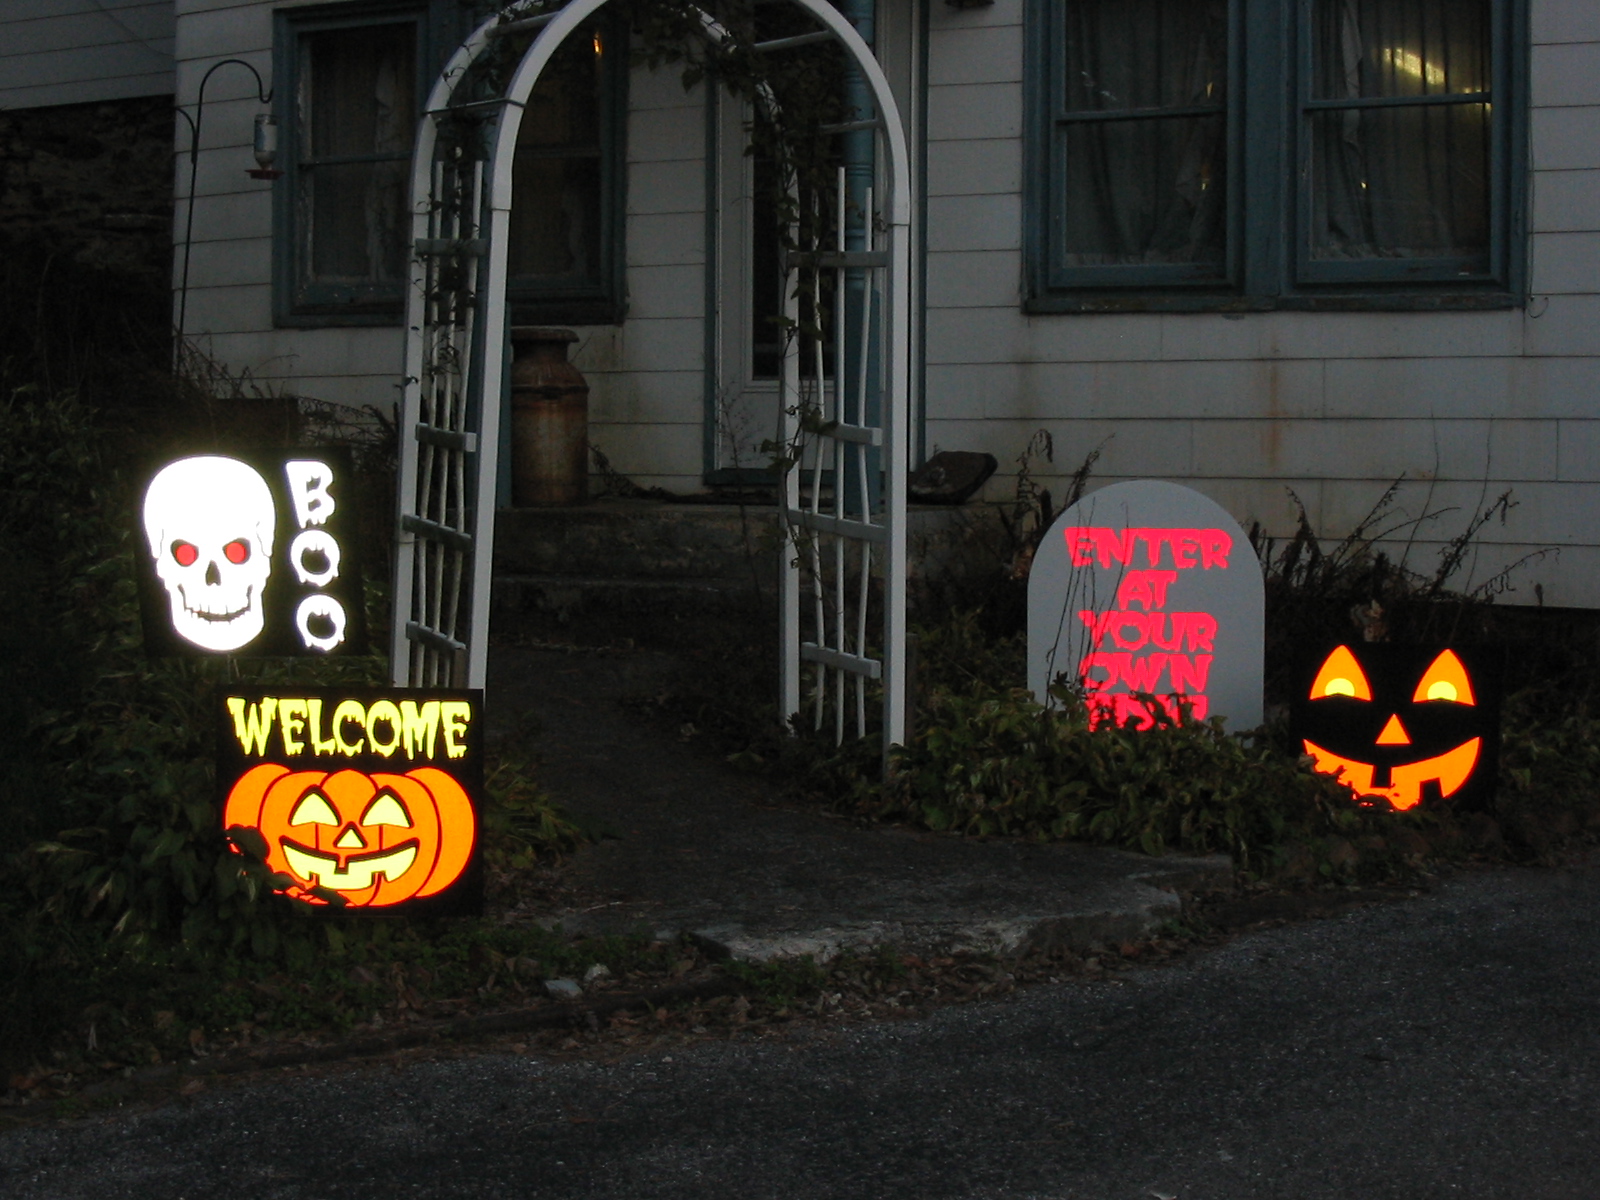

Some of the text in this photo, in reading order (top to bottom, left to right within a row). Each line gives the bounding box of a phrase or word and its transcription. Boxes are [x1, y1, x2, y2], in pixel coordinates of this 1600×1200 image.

[284, 458, 348, 652] BOO
[1064, 527, 1233, 570] ENTER
[1117, 570, 1178, 611] AT
[1077, 610, 1218, 652] YOUR
[1079, 652, 1215, 693] OWN
[226, 696, 472, 760] WELCOME
